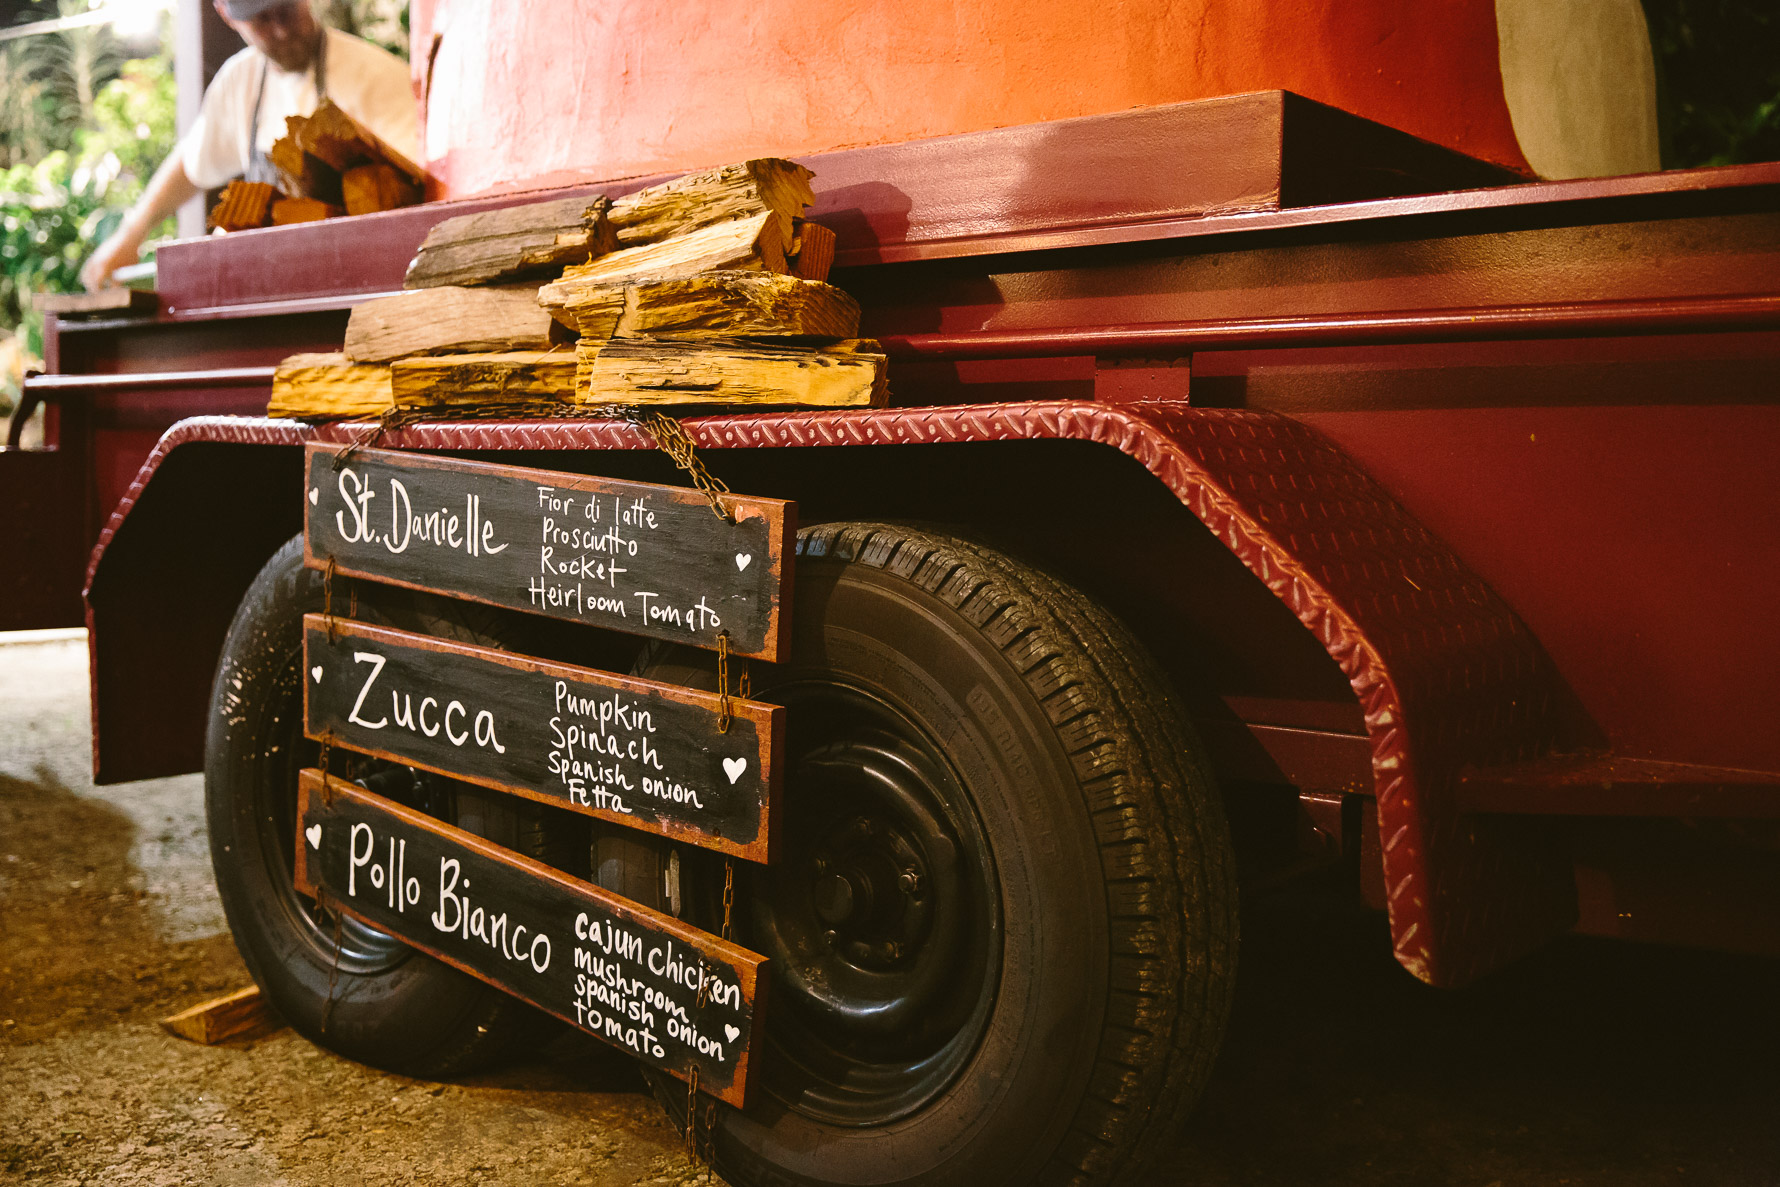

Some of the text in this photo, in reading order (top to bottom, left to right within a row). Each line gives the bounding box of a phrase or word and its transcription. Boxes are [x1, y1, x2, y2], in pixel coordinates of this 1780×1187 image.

[537, 486, 659, 530] Fior di latte
[543, 515, 639, 558] Prosciutto
[541, 546, 628, 588] Rocket
[528, 576, 721, 632] Heirloom Tomato
[348, 651, 505, 754] Zucca
[555, 680, 657, 733] Pumpkin
[548, 717, 663, 770] Spinach
[568, 778, 633, 814] Fetta
[643, 776, 704, 809] onion
[348, 822, 551, 974] Pollo Bianco
[574, 946, 690, 1024] mushroom
[573, 974, 726, 1062] spanish onion
[573, 997, 665, 1058] tomato
